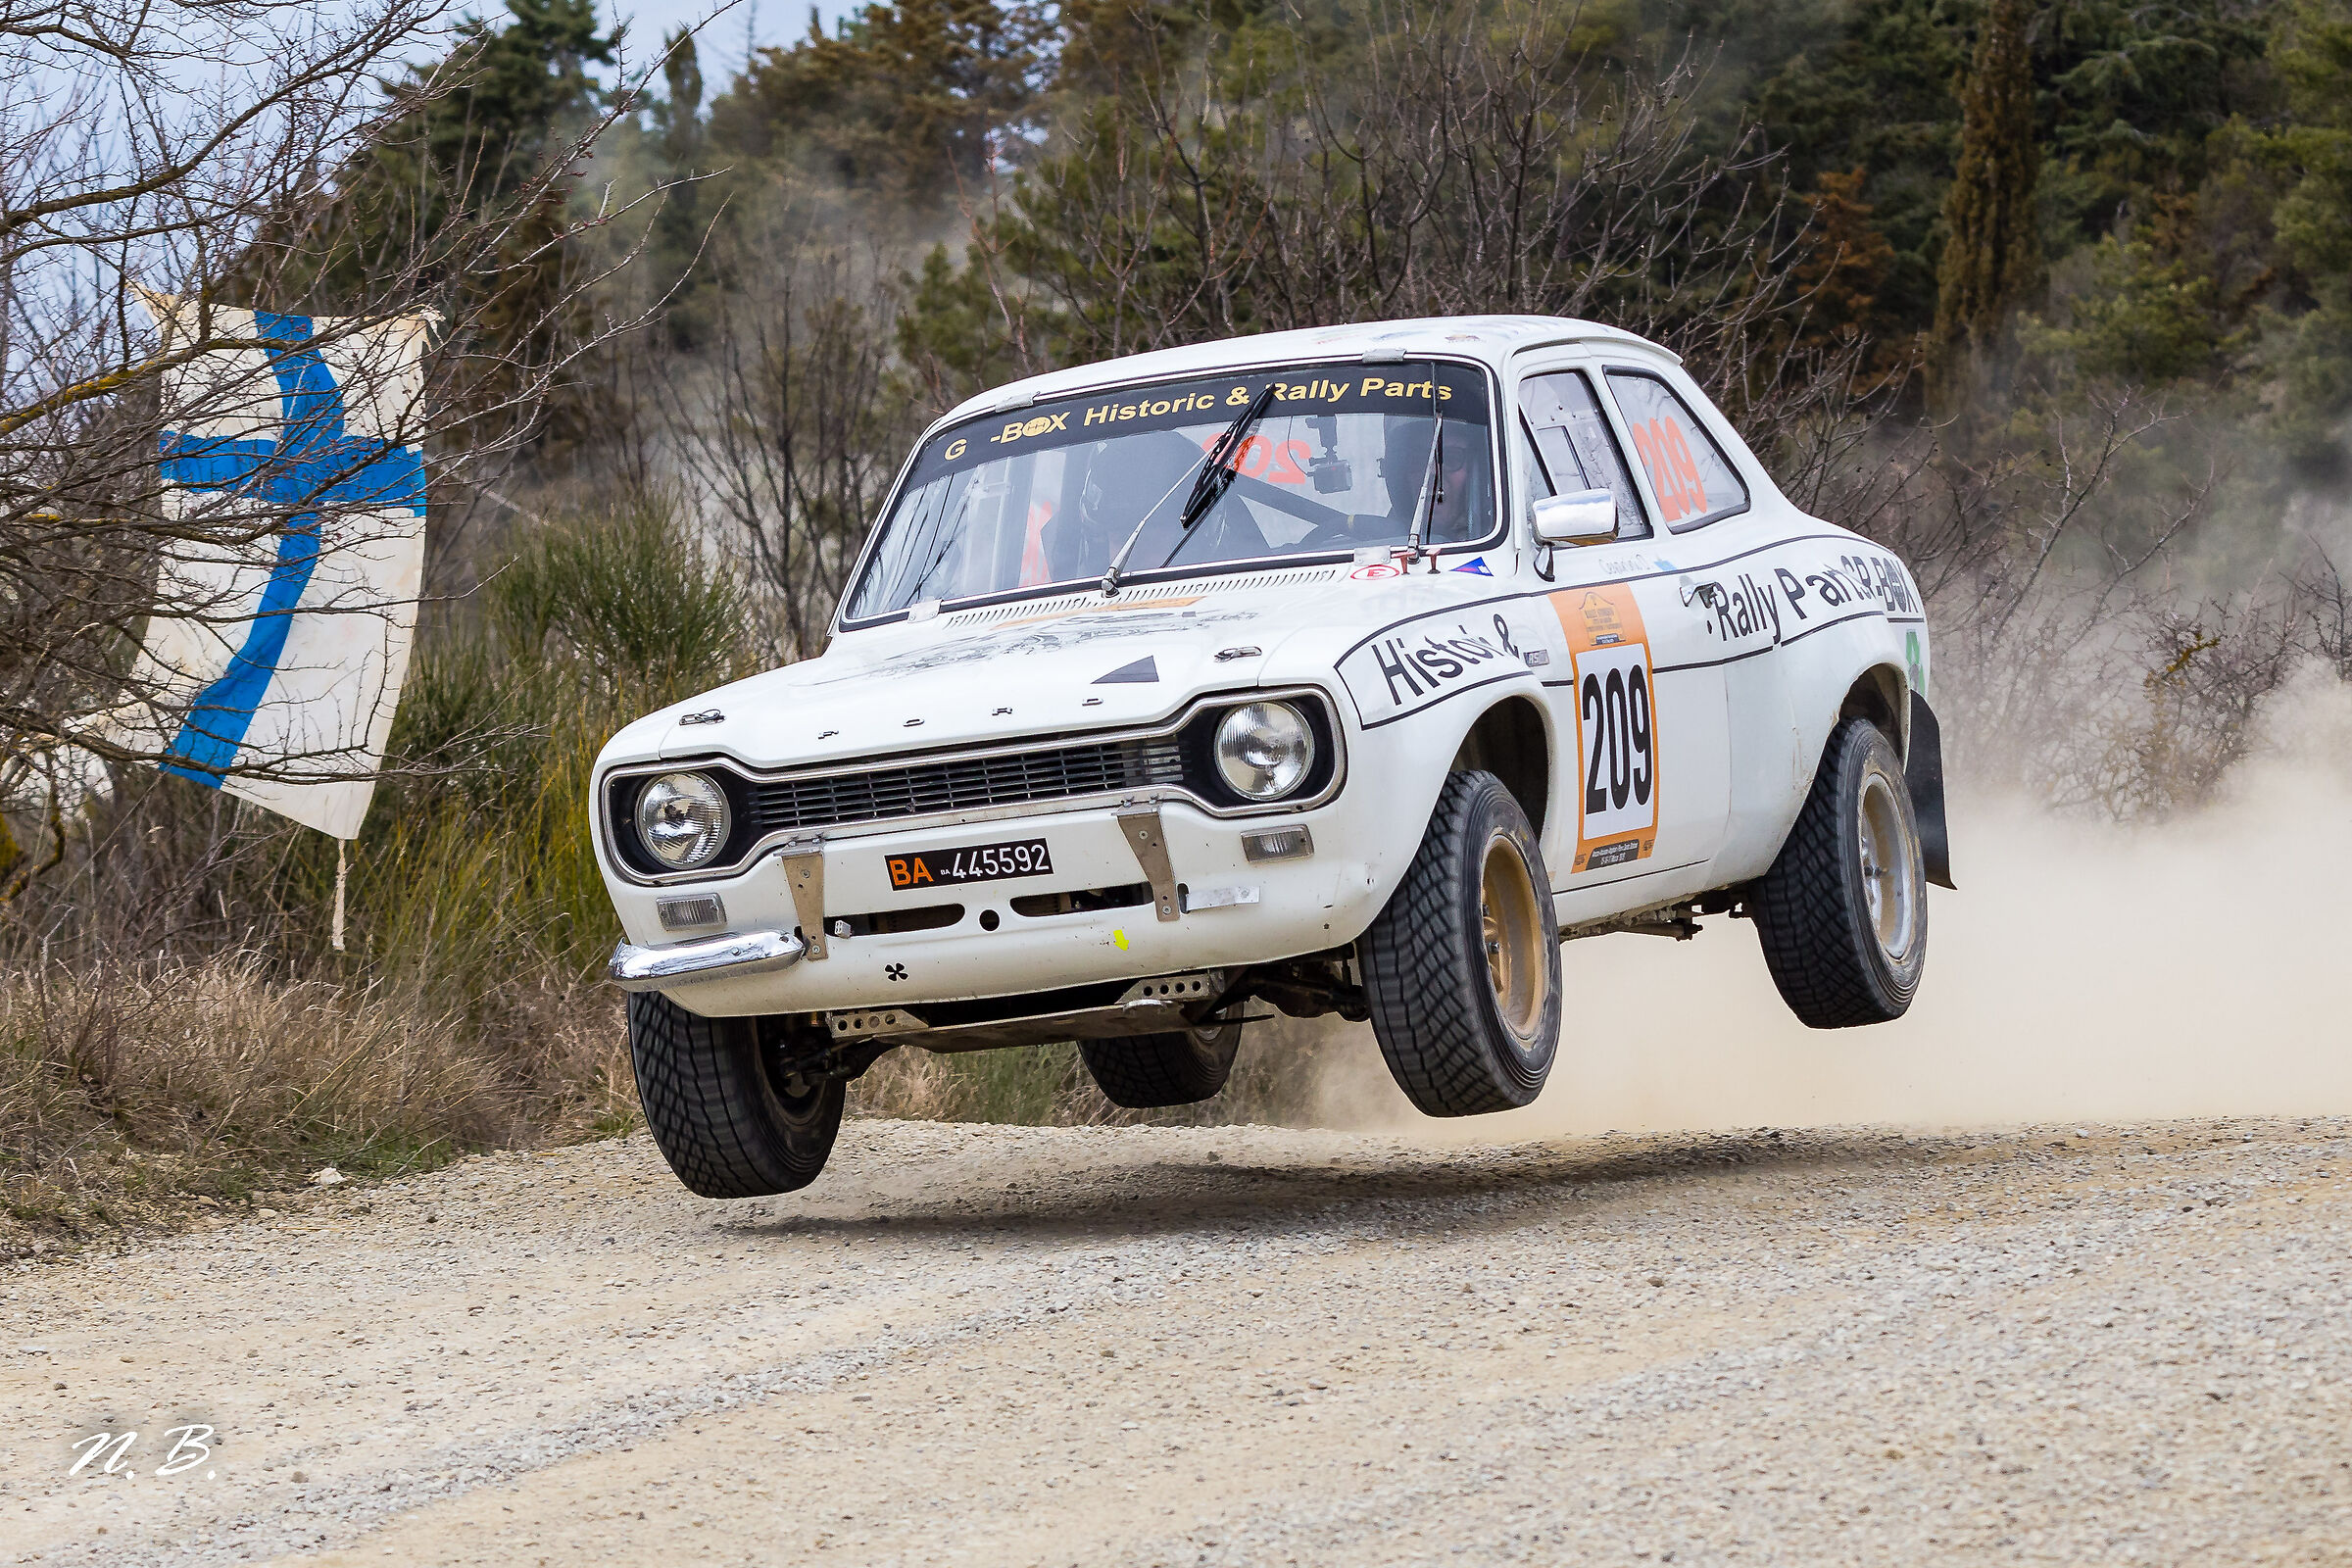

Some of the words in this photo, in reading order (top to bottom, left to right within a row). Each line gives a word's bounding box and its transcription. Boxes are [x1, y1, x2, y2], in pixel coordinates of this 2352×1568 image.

[1083, 392, 1215, 427] Historic
[1225, 386, 1250, 406] &
[1266, 379, 1350, 403] Rally
[1359, 377, 1453, 401] Parts
[1633, 416, 1708, 522] 209
[1712, 581, 1782, 645] Rally
[818, 698, 1104, 740] FORD
[1582, 664, 1652, 815] 209
[889, 857, 934, 886] BA
[953, 844, 1050, 879] 445592
